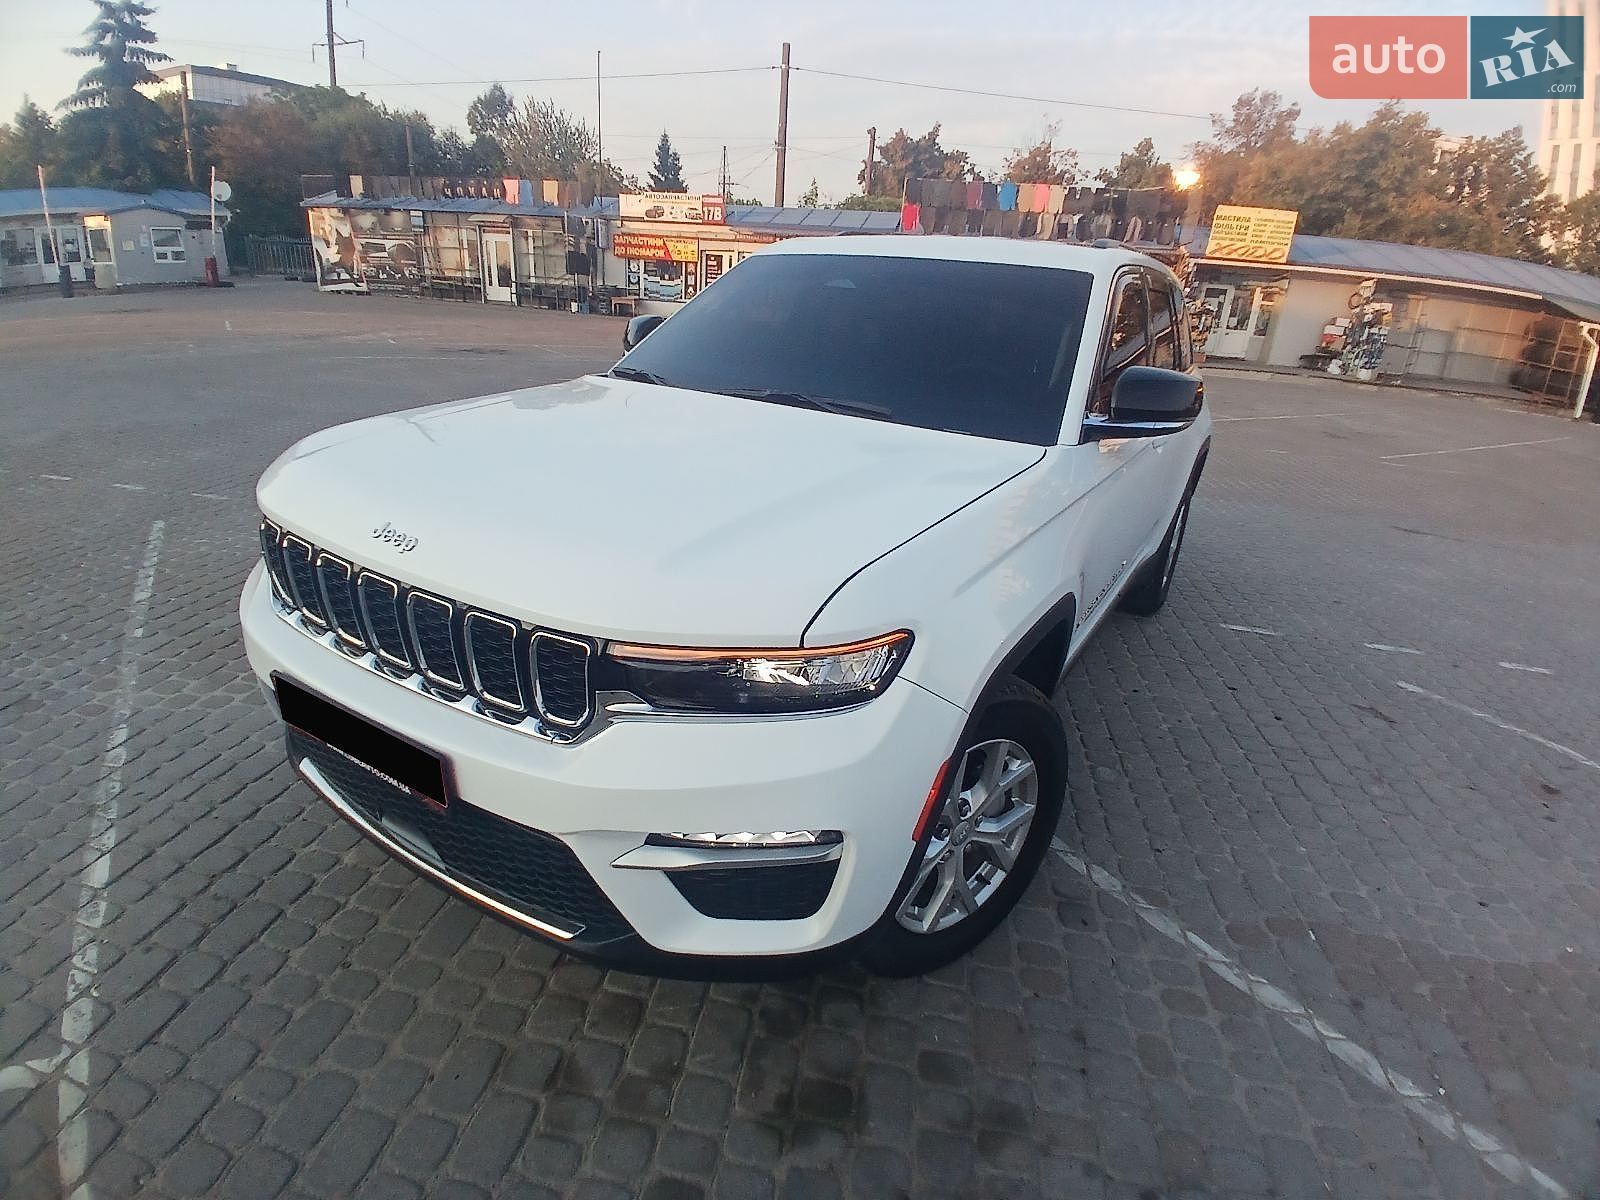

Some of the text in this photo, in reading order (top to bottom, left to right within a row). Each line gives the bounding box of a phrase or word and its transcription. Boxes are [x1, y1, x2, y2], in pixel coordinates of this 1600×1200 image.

[1214, 223, 1250, 231] ФІЛЬТРИ
[613, 235, 664, 247] ЗАПЧАСТИНИ
[614, 246, 625, 256] ДО
[626, 246, 666, 257] ІНОМАРОК
[371, 521, 419, 554] Jeep
